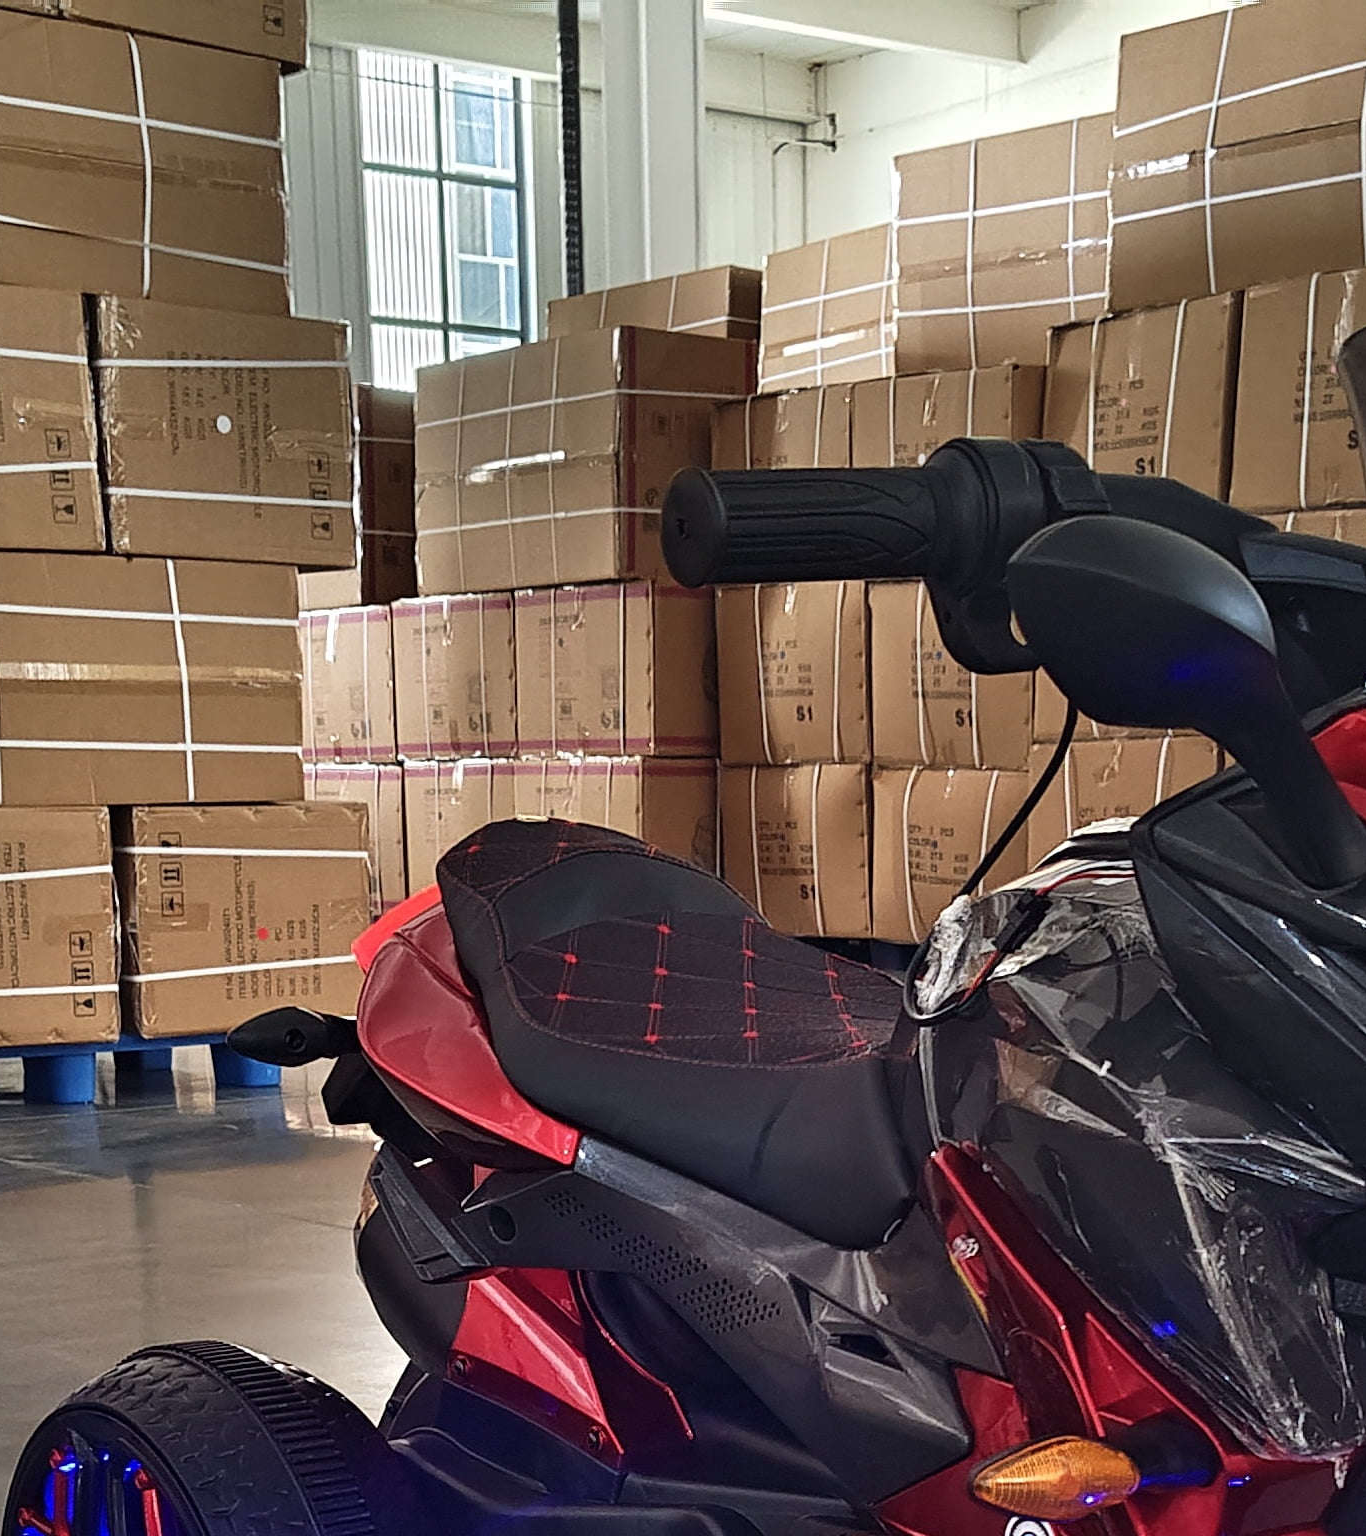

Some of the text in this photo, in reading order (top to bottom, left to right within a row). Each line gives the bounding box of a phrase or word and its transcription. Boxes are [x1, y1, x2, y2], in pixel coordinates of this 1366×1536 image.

[1135, 456, 1155, 475] S1
[796, 706, 813, 722] S1
[5, 881, 15, 925] LECTRIC
[9, 927, 20, 988] MOTORCYCL
[237, 924, 245, 964] LECTRIC
